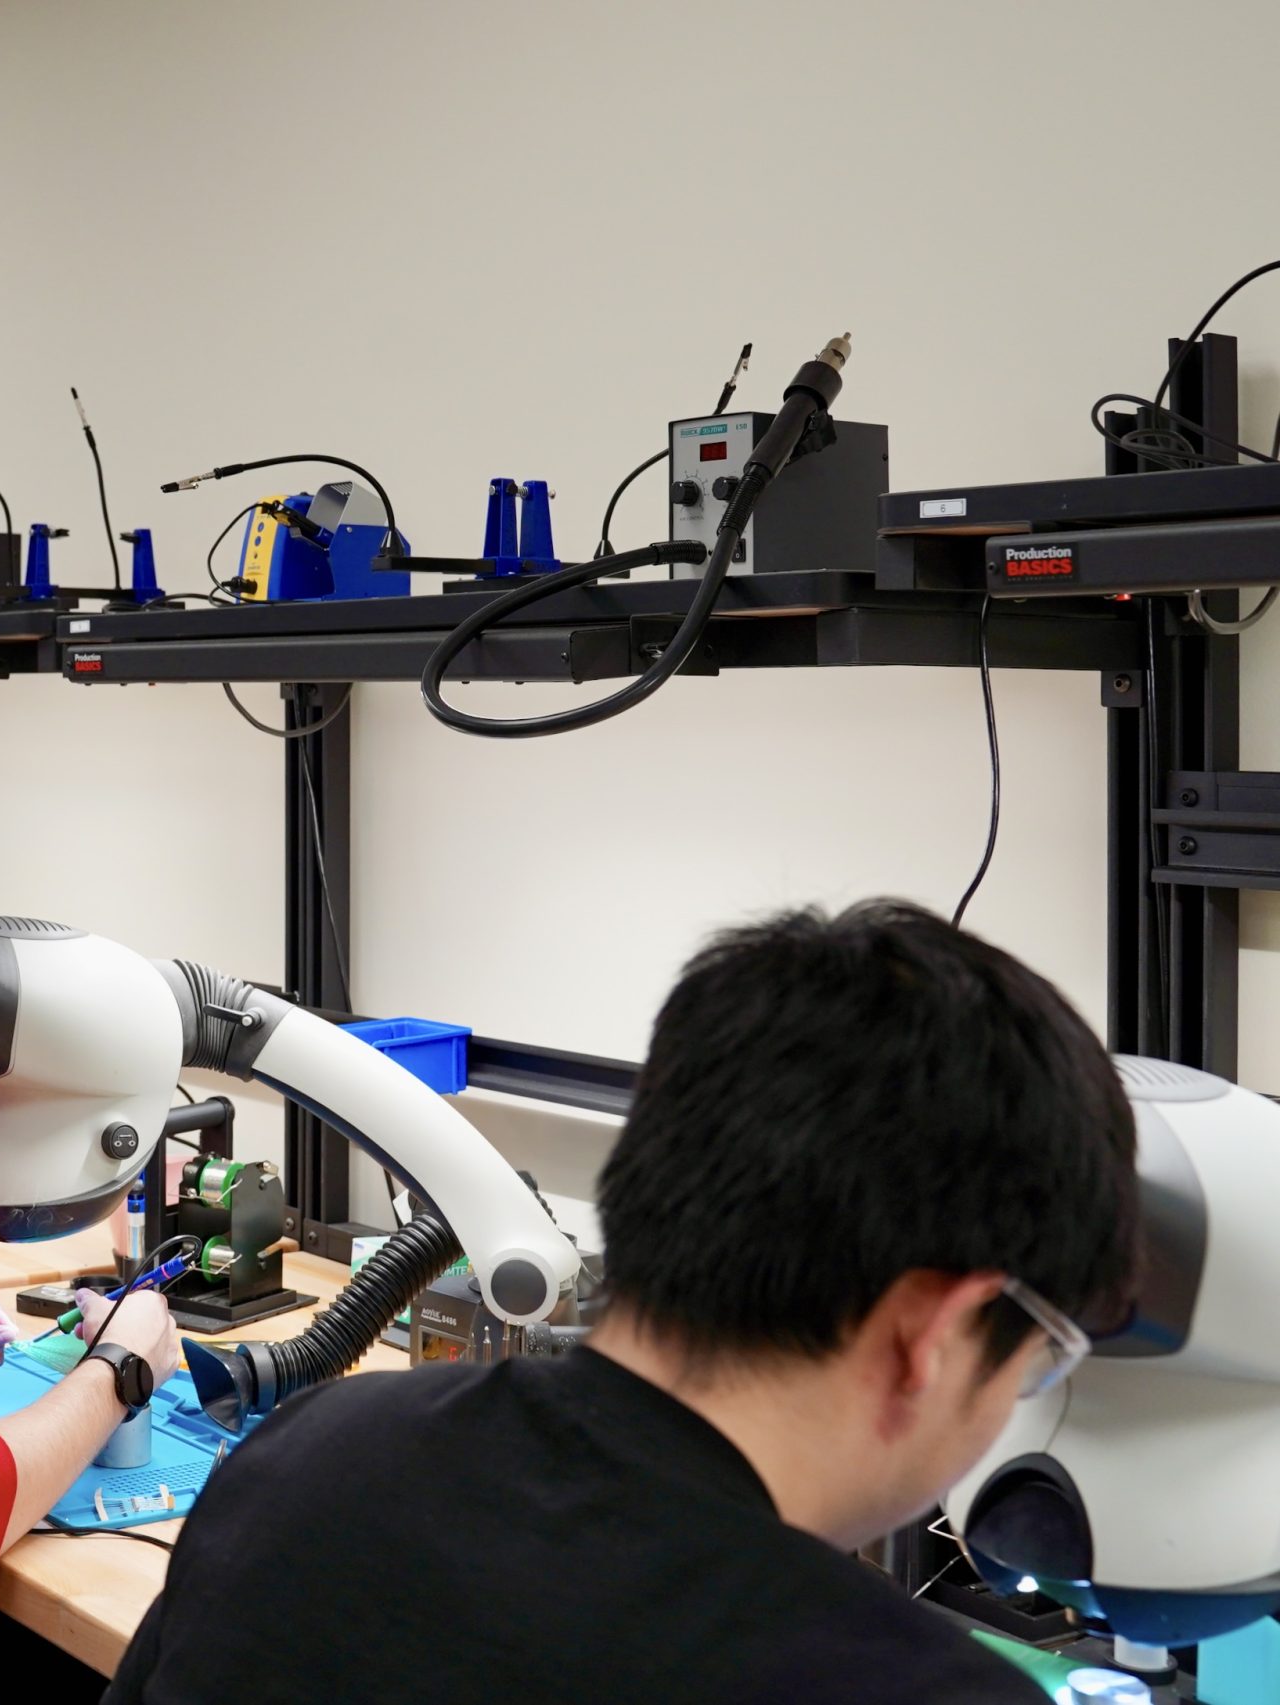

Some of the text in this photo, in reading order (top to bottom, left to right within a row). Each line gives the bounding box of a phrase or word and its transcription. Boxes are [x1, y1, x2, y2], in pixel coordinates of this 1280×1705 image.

[1006, 546, 1072, 560] Production
[1007, 559, 1073, 576] BASICS
[74, 653, 101, 662] Production
